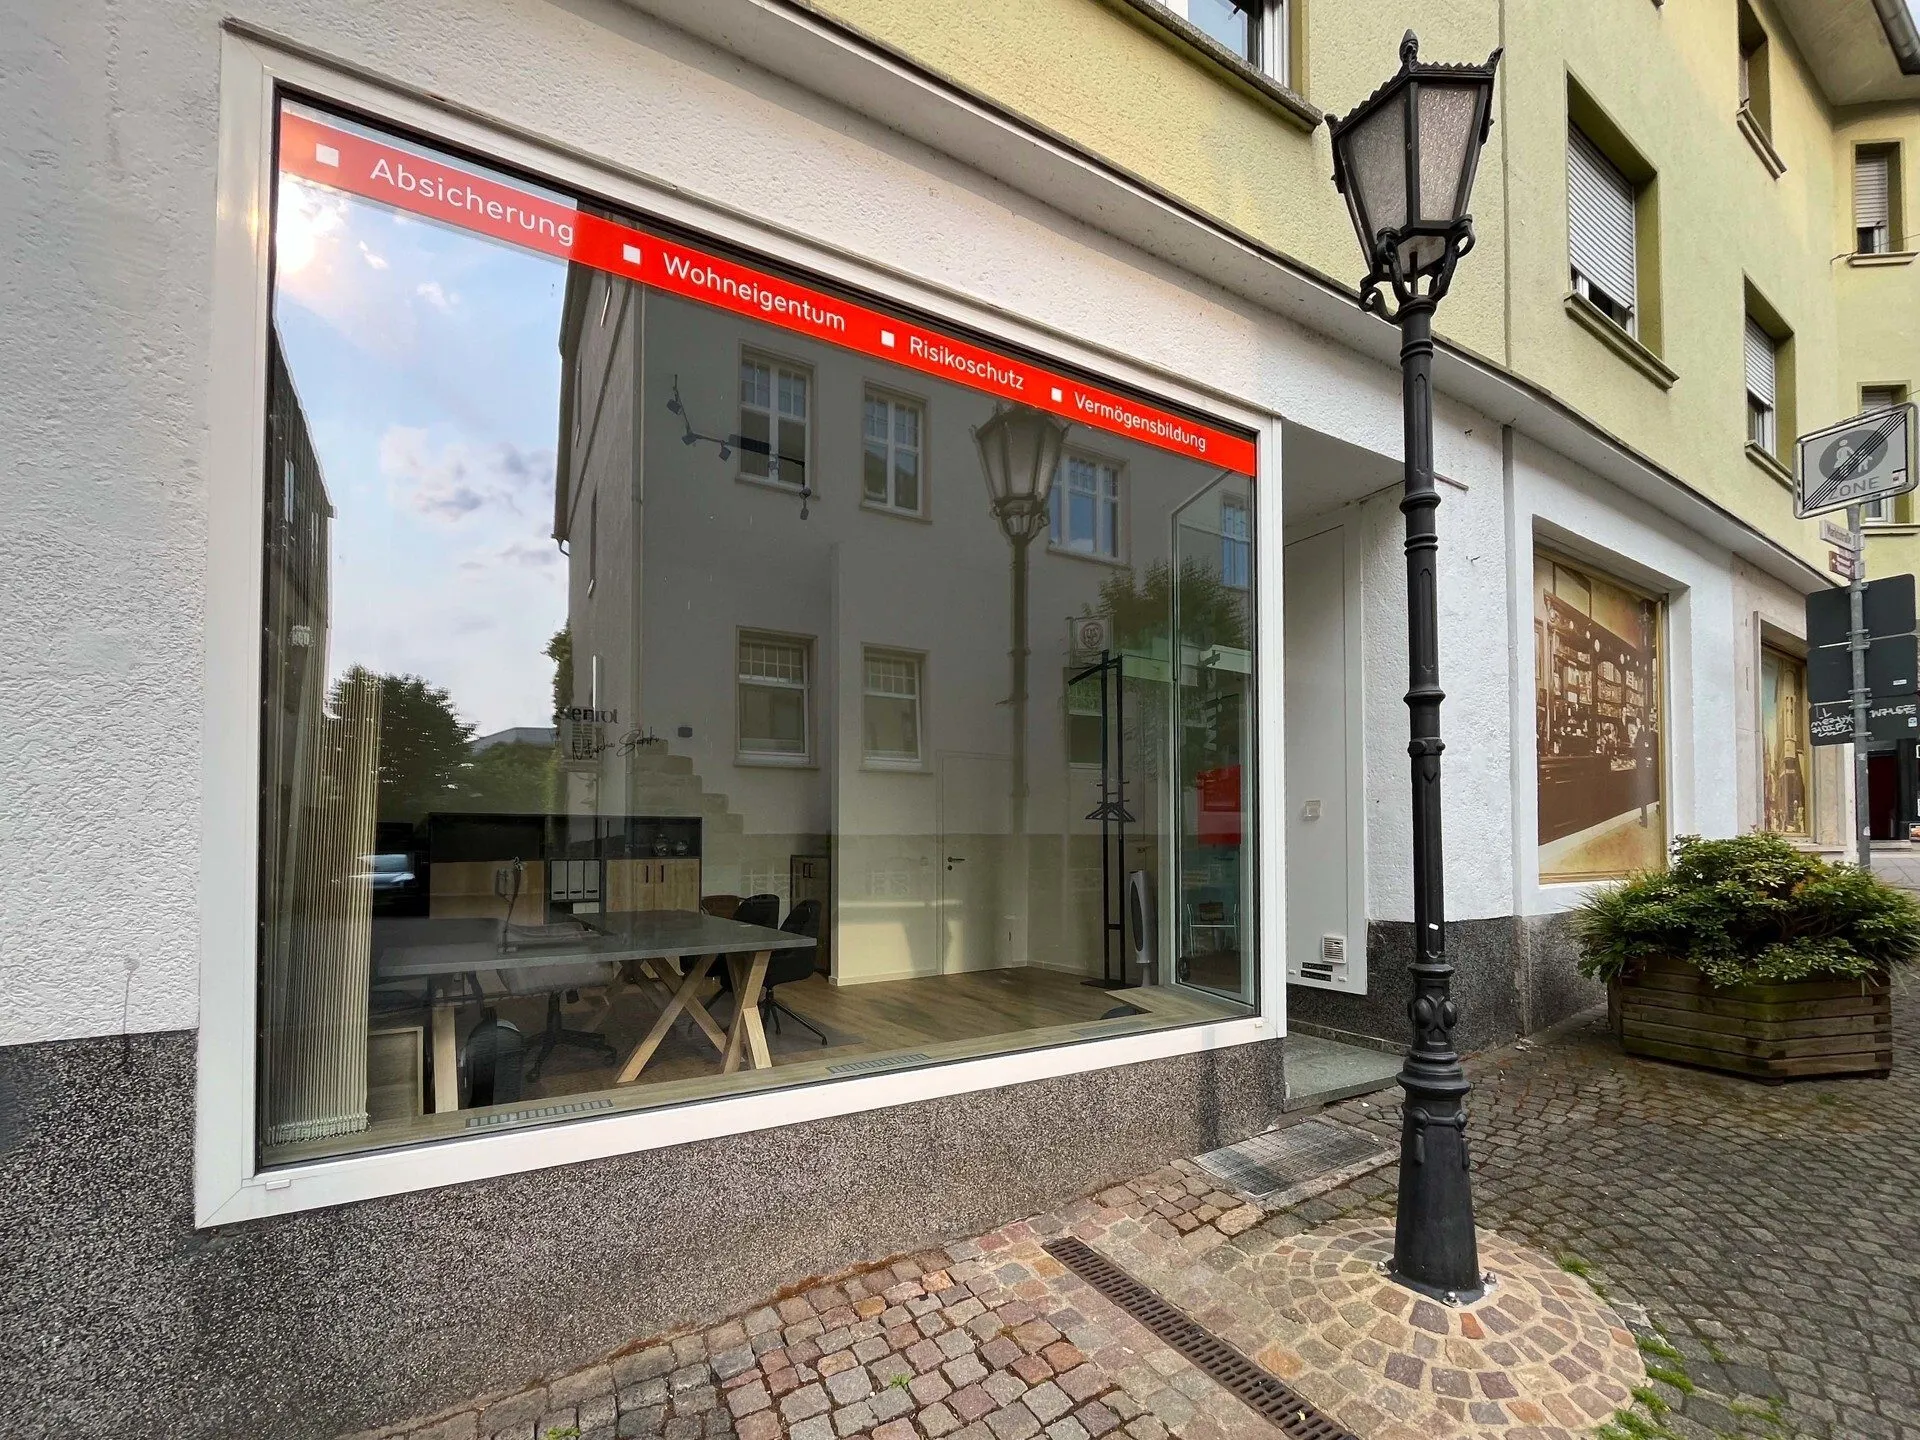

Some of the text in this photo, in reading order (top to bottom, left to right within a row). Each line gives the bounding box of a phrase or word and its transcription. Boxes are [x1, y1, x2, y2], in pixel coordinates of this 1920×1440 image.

[369, 158, 1207, 453] Absicherung Wohneigentum Risikoschutz Vermögensbildung
